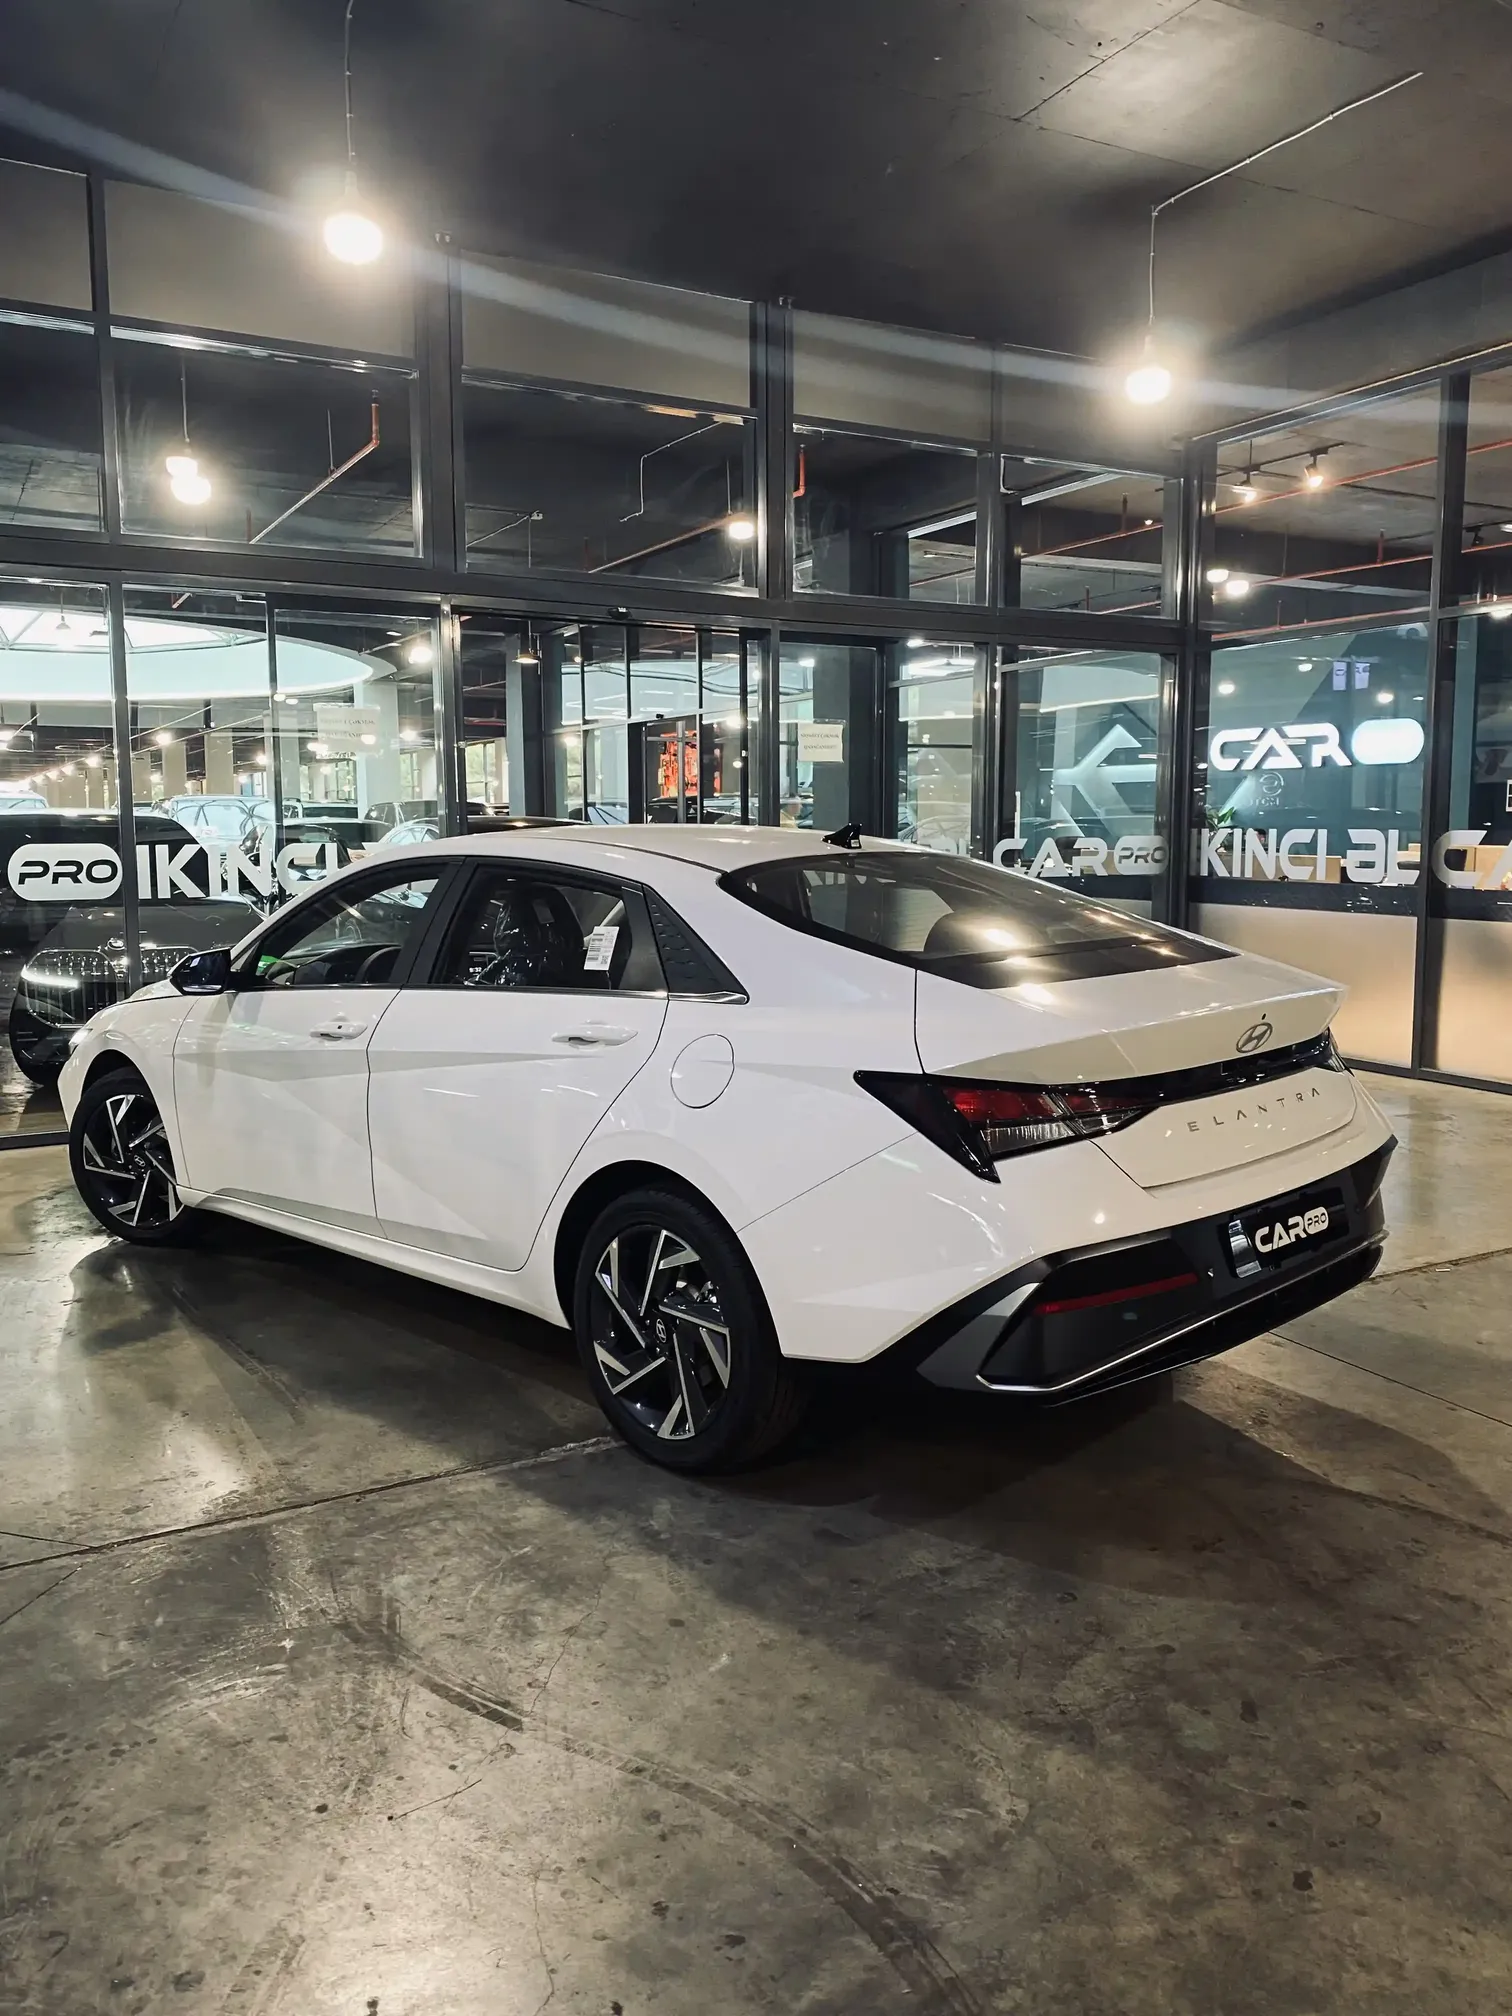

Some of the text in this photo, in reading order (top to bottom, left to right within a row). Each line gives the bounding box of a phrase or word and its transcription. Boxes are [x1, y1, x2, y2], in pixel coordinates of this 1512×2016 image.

[1210, 722, 1352, 771] CAR
[18, 859, 118, 885] PRO
[992, 837, 1109, 878] CAR
[1117, 846, 1167, 865] PRO
[1187, 1087, 1320, 1132] ELANTRA
[1255, 1212, 1327, 1253] CAR PRO
